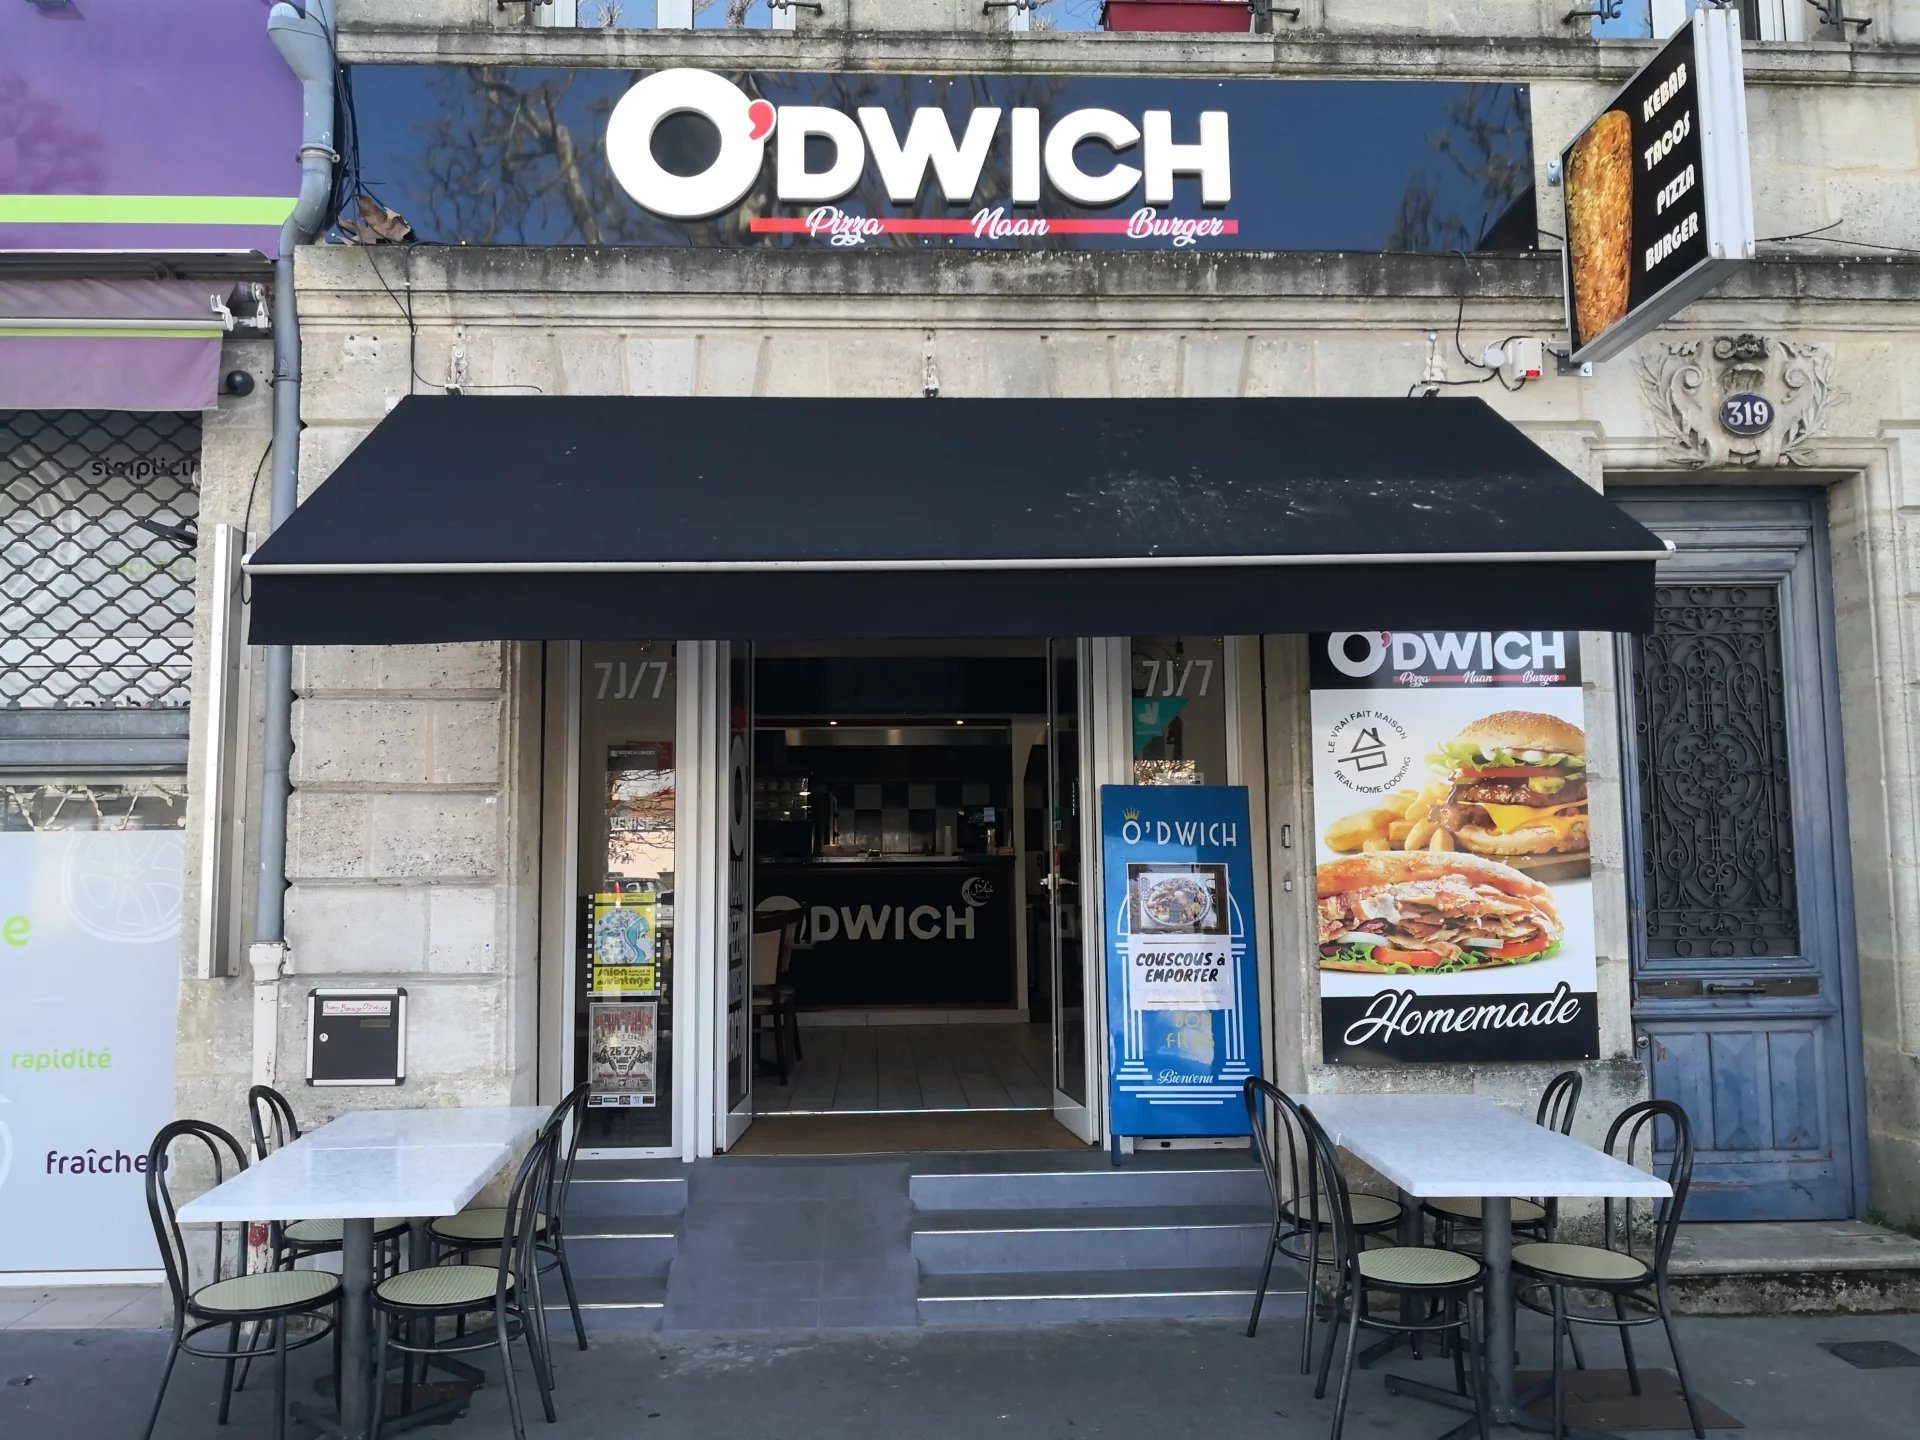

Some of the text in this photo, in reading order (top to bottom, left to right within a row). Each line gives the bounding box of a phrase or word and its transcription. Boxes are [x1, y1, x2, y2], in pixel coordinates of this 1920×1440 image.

[1643, 62, 1688, 123] KEBAB
[605, 67, 1232, 218] O'DWICH
[1645, 110, 1690, 172] TACOS
[1657, 163, 1695, 215] PIZZA
[805, 206, 1224, 247] Pizza Naan Burger
[1646, 211, 1698, 272] BURGER
[1727, 401, 1769, 426] 319
[1327, 631, 1566, 678] O'DWICH
[594, 661, 668, 700] 7J/7
[1142, 660, 1213, 697] 7J/7
[1400, 670, 1560, 688] Pizza Naan Burger
[1328, 710, 1407, 753] LE VRAI FAIT MAISON
[1334, 756, 1411, 794] REAL HOME COOKING
[1135, 952, 1226, 967] COUSCOUS à
[1145, 968, 1219, 983] EMPORTER
[1343, 986, 1581, 1046] Homemade
[11, 1046, 111, 1073] rapidité
[609, 1046, 637, 1056] 26 27
[1157, 1068, 1213, 1084] Bienvenu
